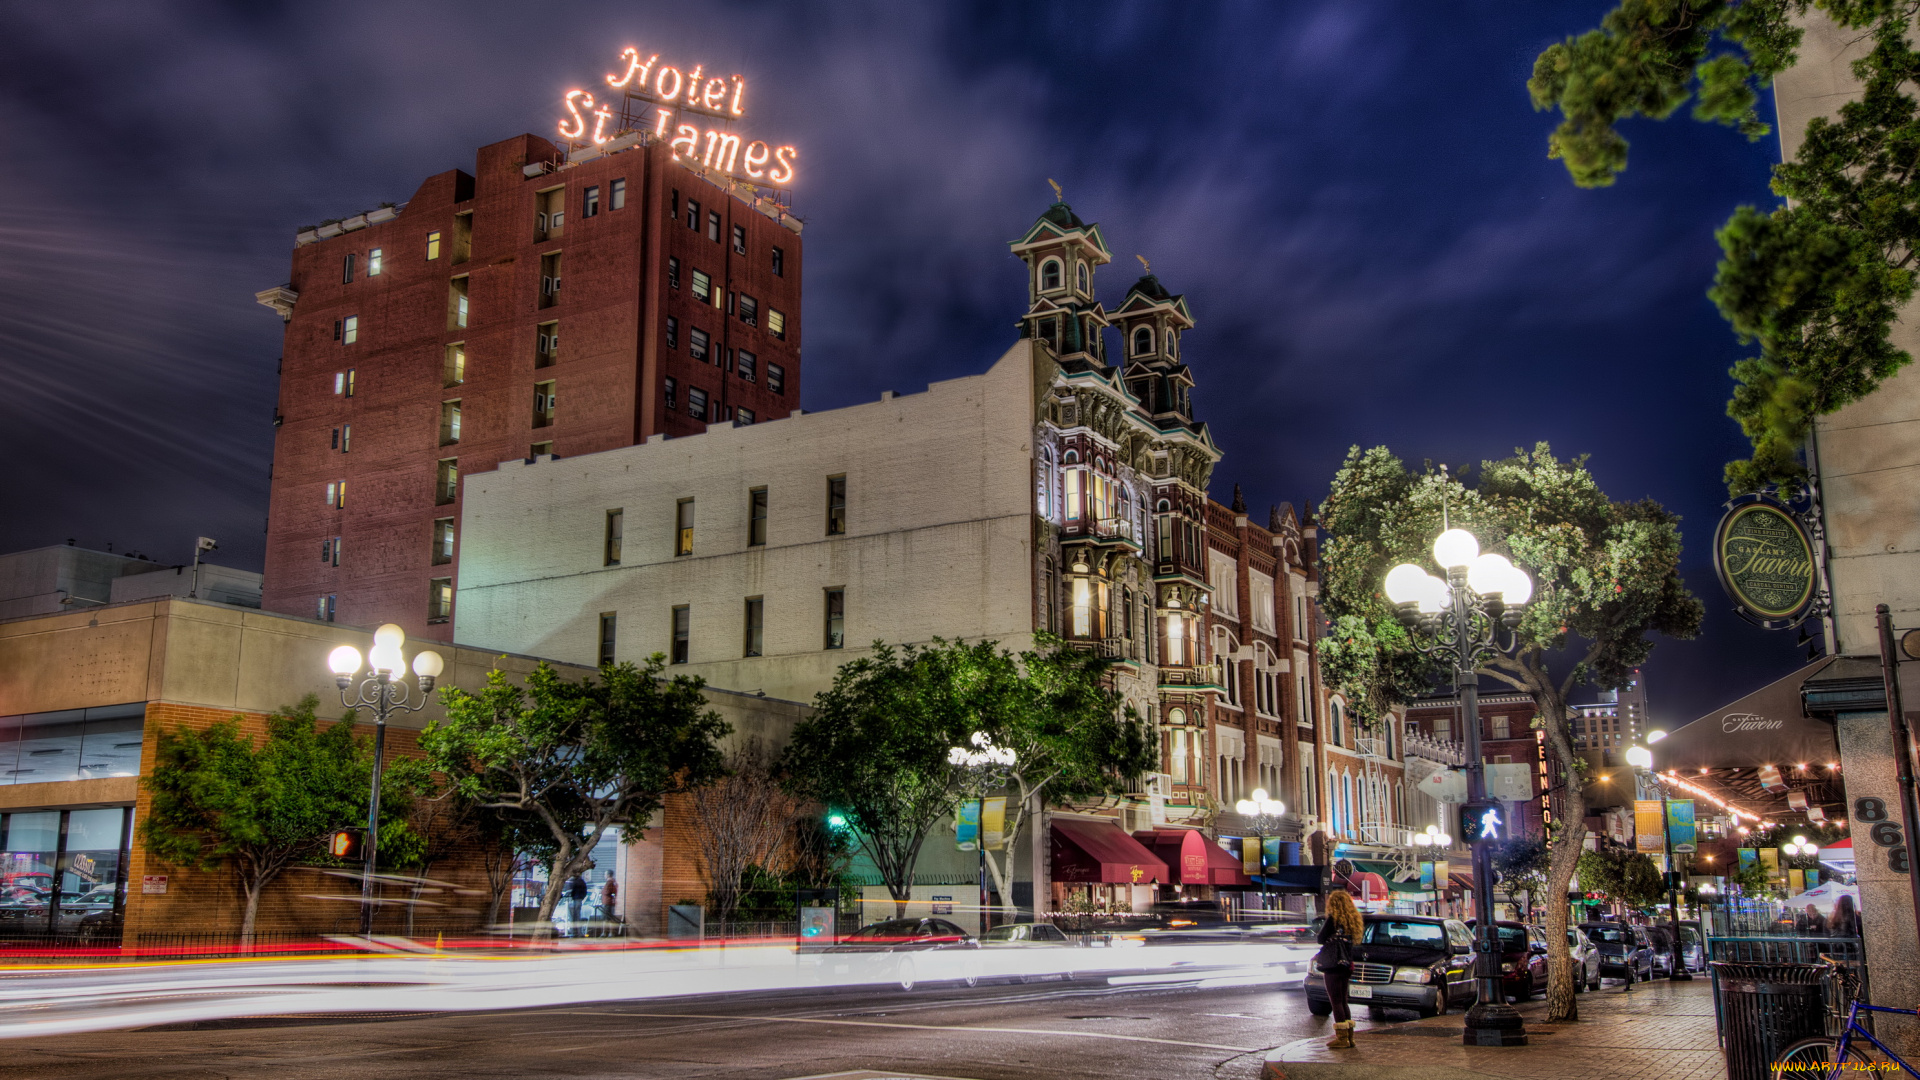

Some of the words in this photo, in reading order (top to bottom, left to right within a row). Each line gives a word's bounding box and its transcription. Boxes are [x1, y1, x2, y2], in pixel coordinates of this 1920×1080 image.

[606, 47, 746, 114] Hotel
[656, 108, 797, 183] James
[1722, 536, 1815, 577] Tavern
[1738, 546, 1786, 556] GASLAMP
[1721, 712, 1784, 733] Tavern
[1854, 796, 1910, 874] 868
